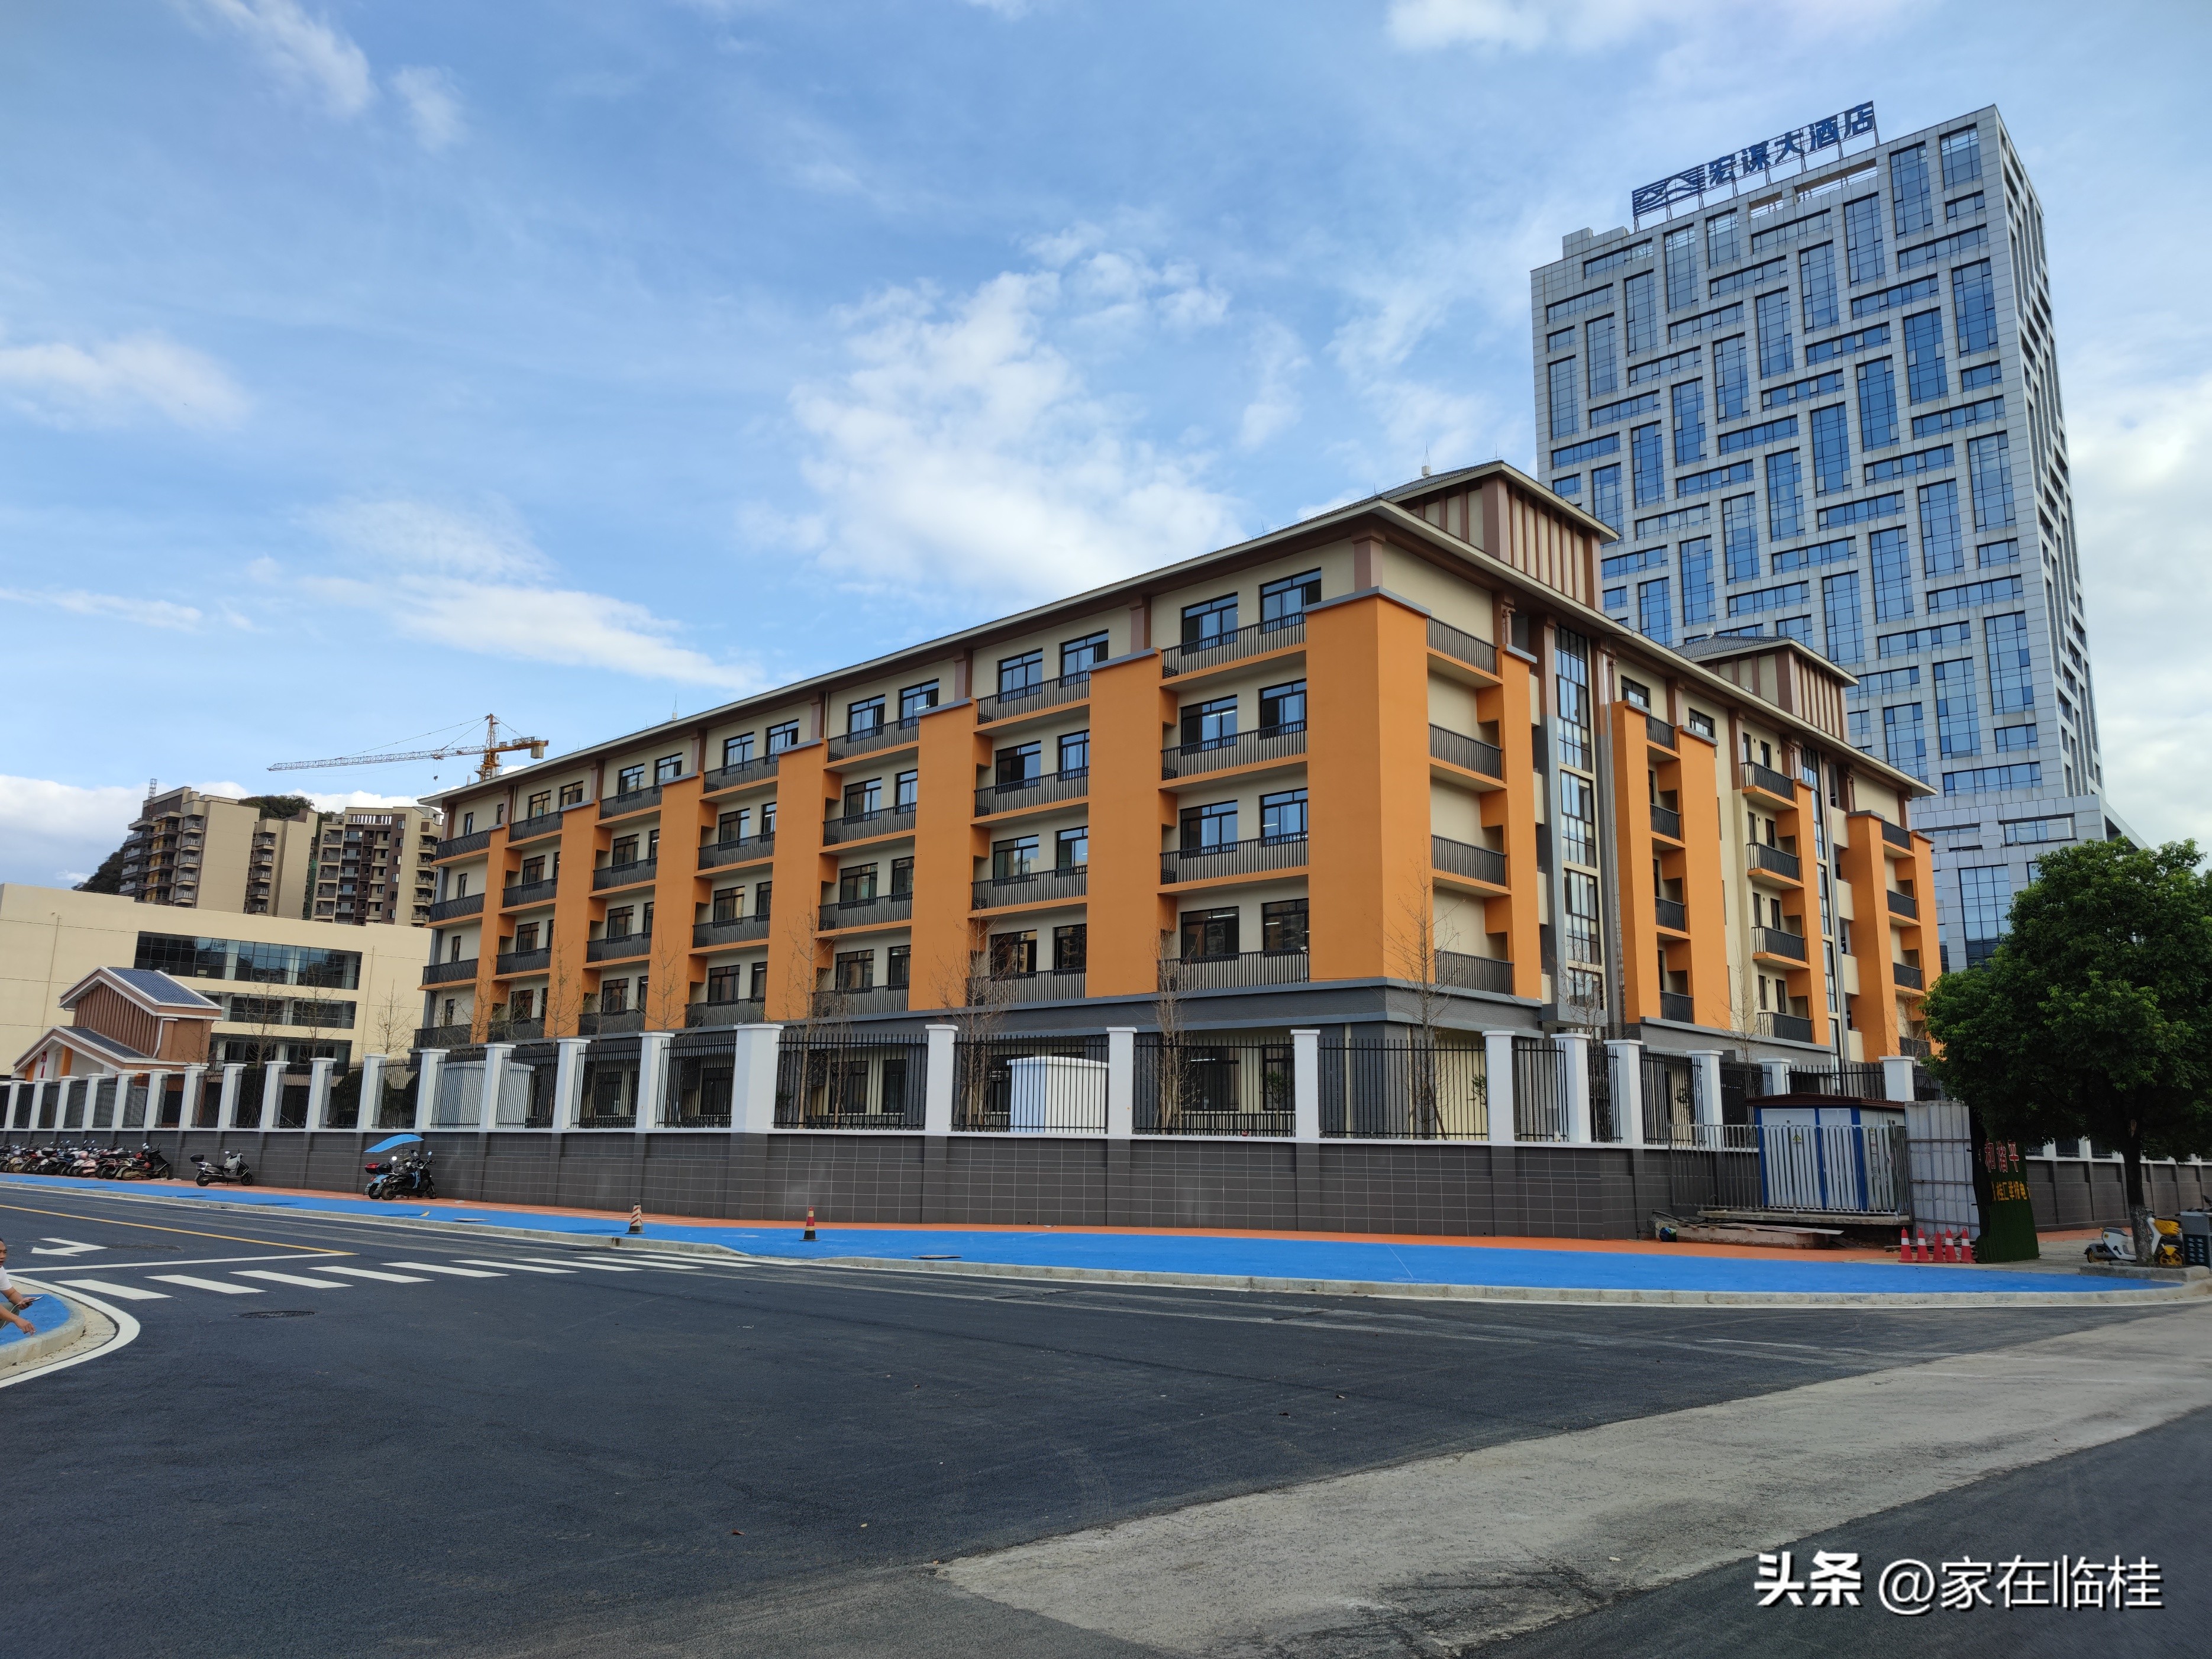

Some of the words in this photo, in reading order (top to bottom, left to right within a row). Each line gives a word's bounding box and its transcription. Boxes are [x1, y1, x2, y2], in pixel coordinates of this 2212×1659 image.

[1709, 104, 1874, 185] 宏谋大酒店
